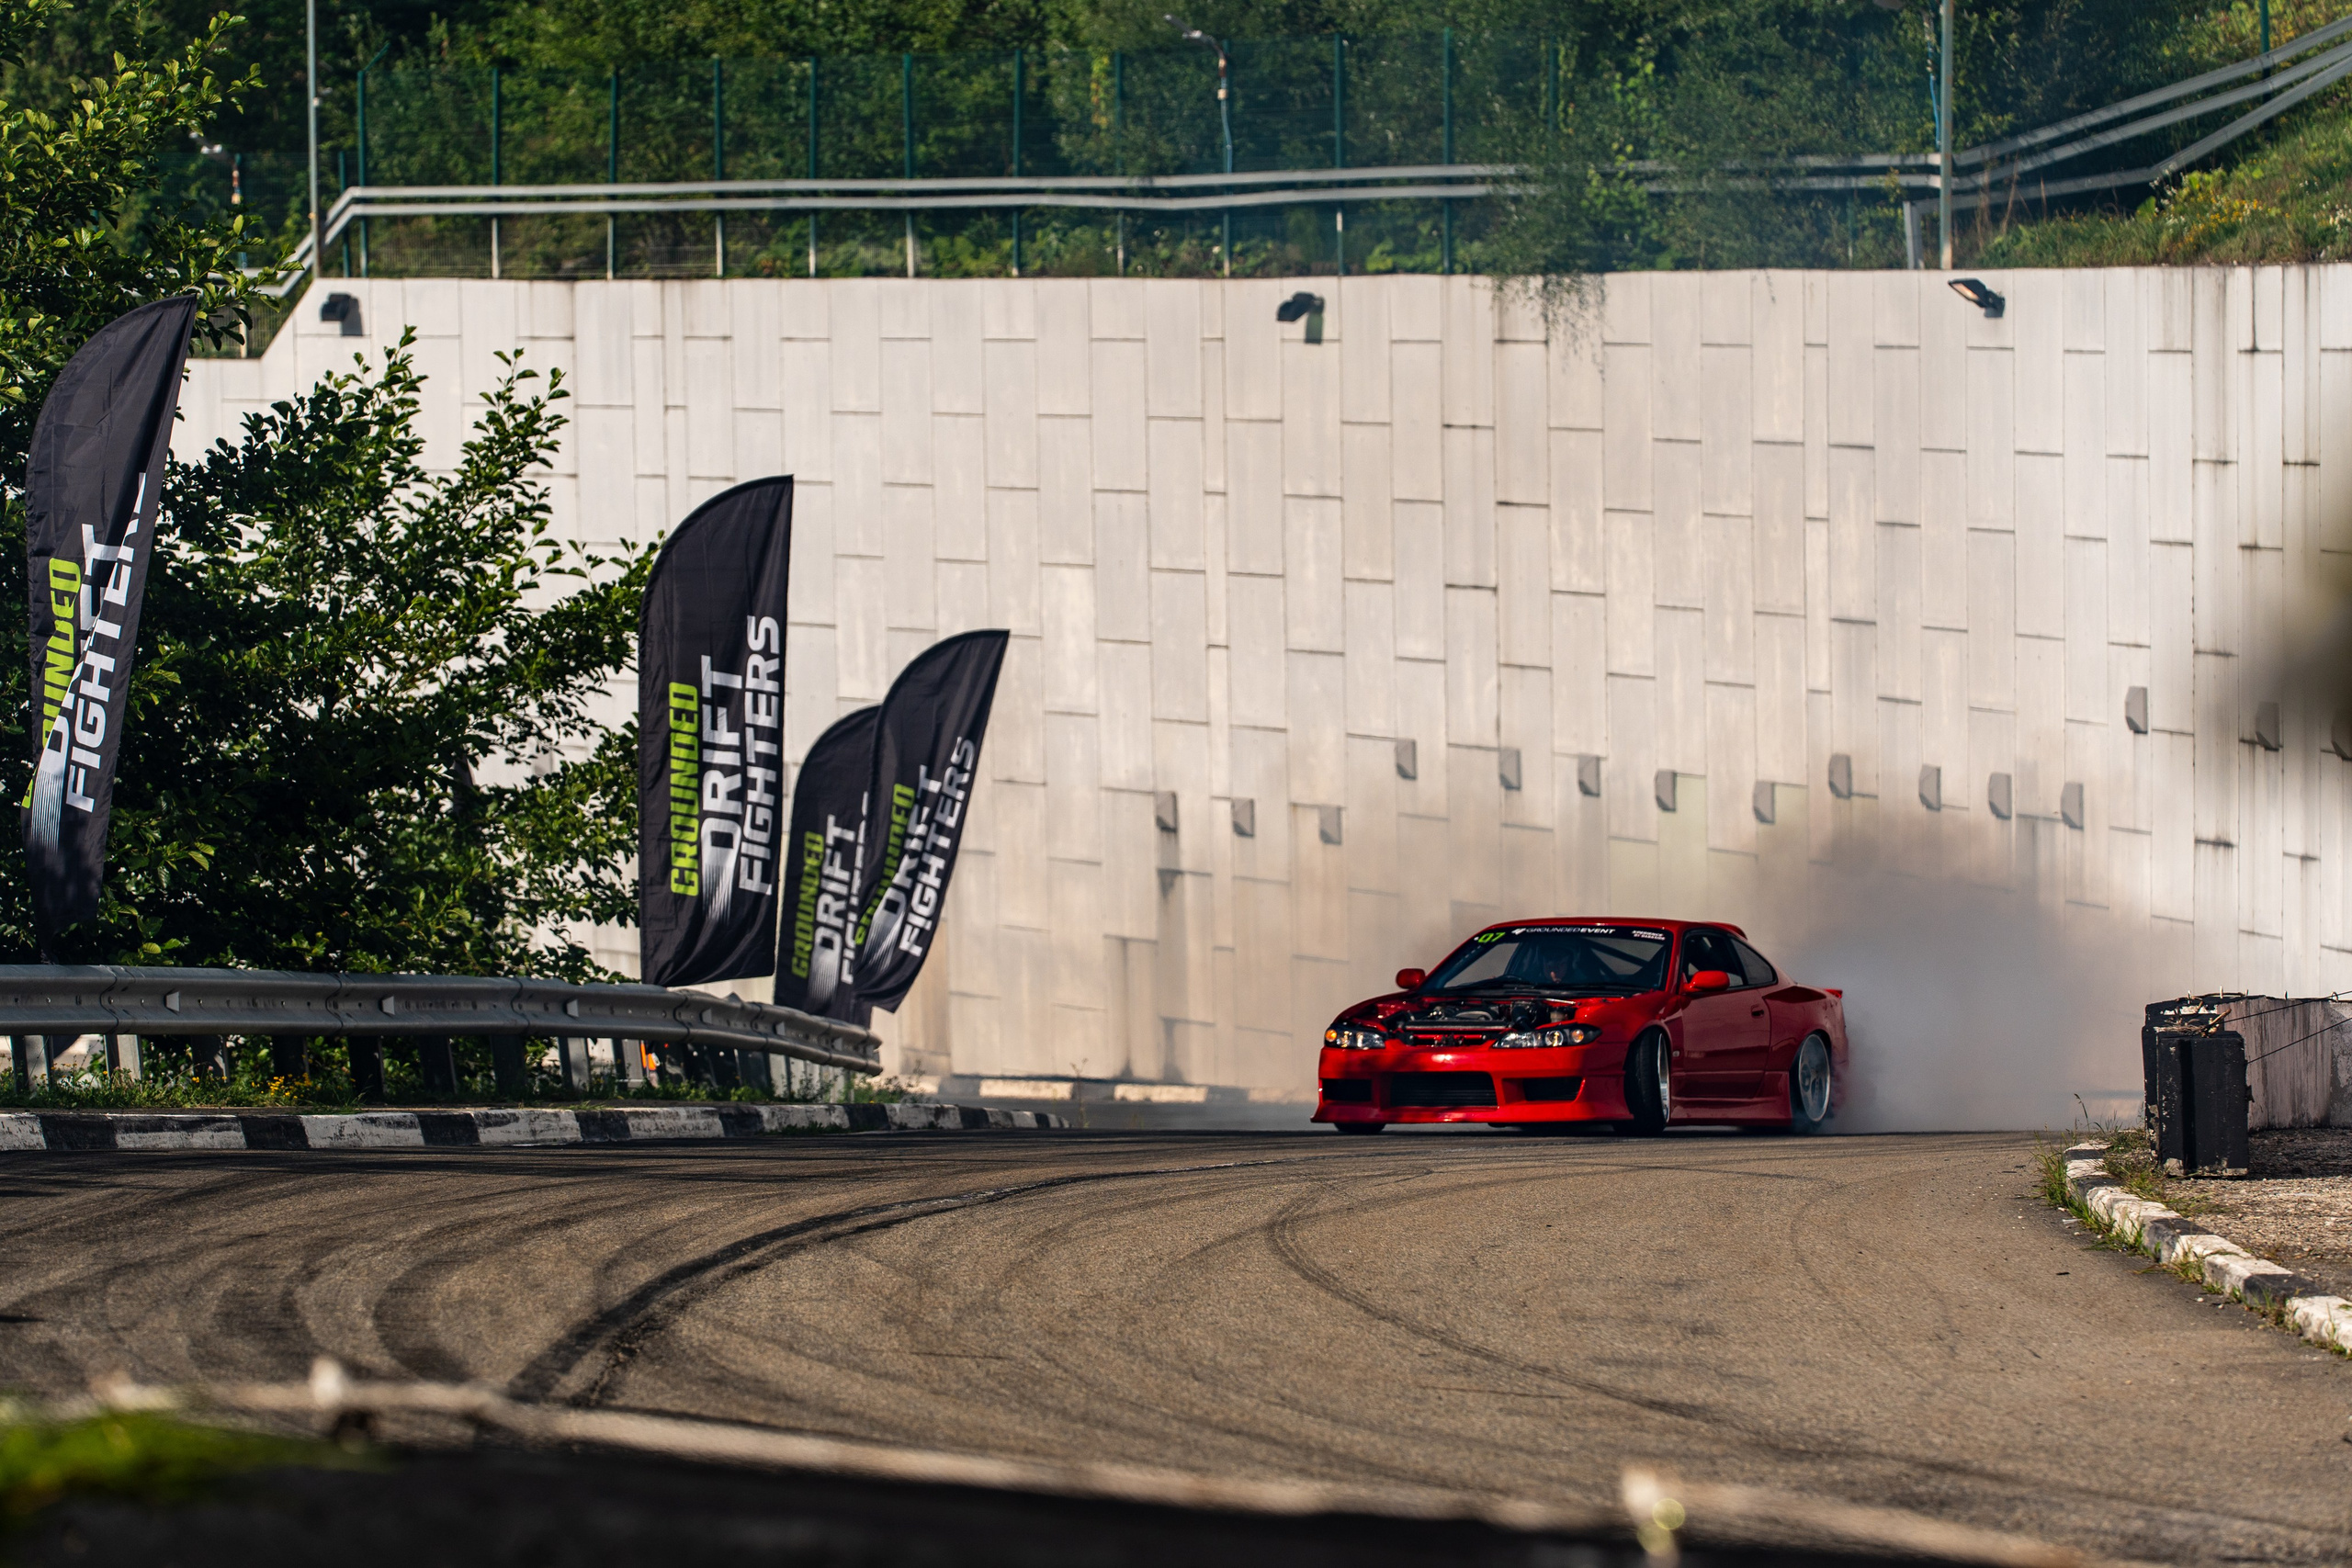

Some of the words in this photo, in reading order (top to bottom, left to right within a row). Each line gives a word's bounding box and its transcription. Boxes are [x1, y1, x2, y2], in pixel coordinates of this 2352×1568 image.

[669, 682, 699, 897] GROUNDED
[701, 654, 742, 898] DRIFT
[739, 615, 780, 897] FIGHTERS
[899, 736, 975, 957] FIGHTERS
[791, 830, 825, 979] GROUNDED
[808, 814, 855, 979] DRIFT
